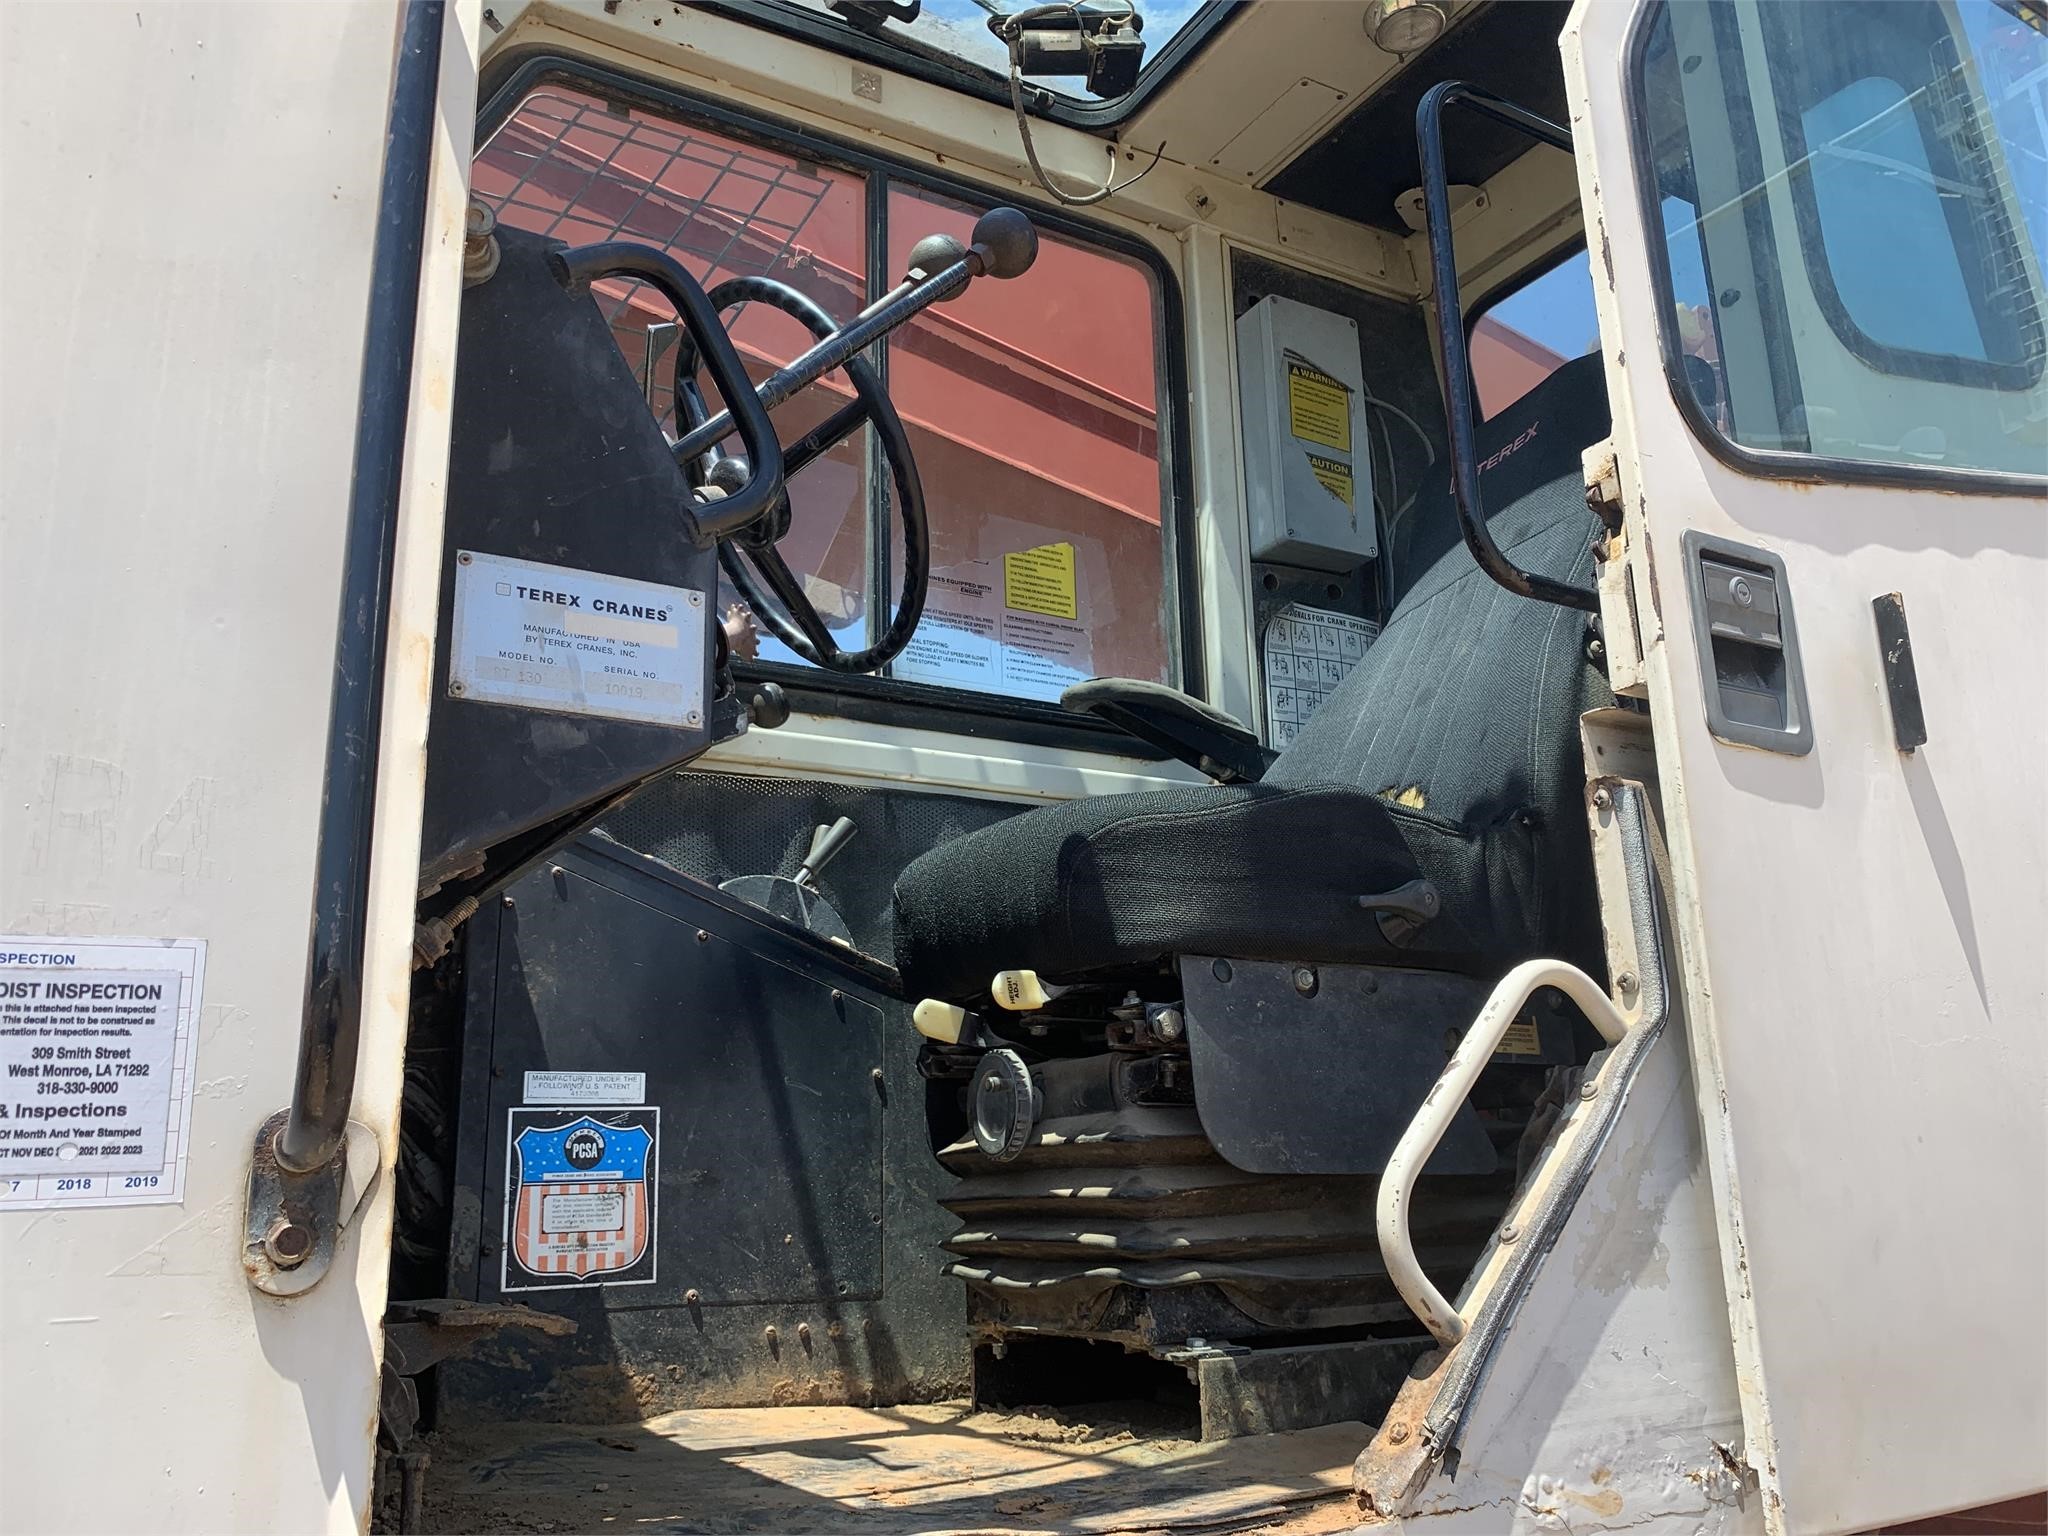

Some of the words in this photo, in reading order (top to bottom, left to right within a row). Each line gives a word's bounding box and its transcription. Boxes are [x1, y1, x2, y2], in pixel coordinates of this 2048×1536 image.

[1476, 421, 1540, 476] TEREX
[1309, 457, 1349, 474] AUTION
[516, 586, 581, 608] TEREX
[593, 599, 667, 621] CRANES
[1312, 614, 1325, 623] FOR
[1327, 616, 1346, 627] CRANE
[525, 635, 538, 643] BY
[543, 638, 572, 648] TEREX
[576, 643, 615, 655] CRANES,
[620, 649, 637, 658] INC.
[499, 650, 535, 661] MODEL
[539, 656, 557, 665] NO.
[603, 665, 638, 676] SERIAL
[642, 671, 659, 679] NO.
[0, 953, 75, 965] SPECTION
[0, 982, 41, 998] OIST
[45, 983, 162, 1000] INSPECTION
[1007, 976, 1015, 1004] HEIGHT
[5, 1004, 21, 1013] this
[23, 1004, 31, 1013] is
[33, 1004, 72, 1013] attached
[74, 1004, 90, 1013] has
[92, 1005, 113, 1013] been
[115, 1005, 156, 1015] inspected
[3, 1016, 21, 1024] This
[23, 1016, 48, 1024] decal
[50, 1016, 58, 1024] is
[60, 1016, 75, 1024] not
[76, 1016, 86, 1025] to
[87, 1016, 99, 1025] be
[100, 1017, 144, 1025] construed
[0, 1028, 37, 1036] entation
[39, 1028, 53, 1036] for
[54, 1028, 99, 1038] inspection
[101, 1028, 132, 1036] results.
[32, 1047, 54, 1059] 309
[56, 1047, 92, 1059] Smith
[95, 1047, 131, 1059] Street
[8, 1064, 39, 1077] West
[42, 1064, 92, 1078] Monroe,
[95, 1064, 112, 1077] LA
[115, 1064, 150, 1077] 71292
[532, 1074, 593, 1082] MANUFACTURED
[37, 1081, 118, 1094] 318-330-9000
[538, 1082, 582, 1090] FOLLOWING
[0, 1104, 9, 1118] &
[15, 1103, 127, 1121] Inspections
[13, 1128, 47, 1139] Month
[48, 1128, 70, 1139] And
[73, 1127, 95, 1138] Year
[97, 1127, 141, 1138] Stamped
[11, 1147, 32, 1158] NOV
[34, 1147, 54, 1157] DEC
[79, 1146, 98, 1156] 2021
[101, 1146, 121, 1156] 2022
[122, 1145, 143, 1155] 2023
[573, 1143, 598, 1158] PCSA
[57, 1178, 92, 1191] 2018
[125, 1176, 159, 1188] 2019
